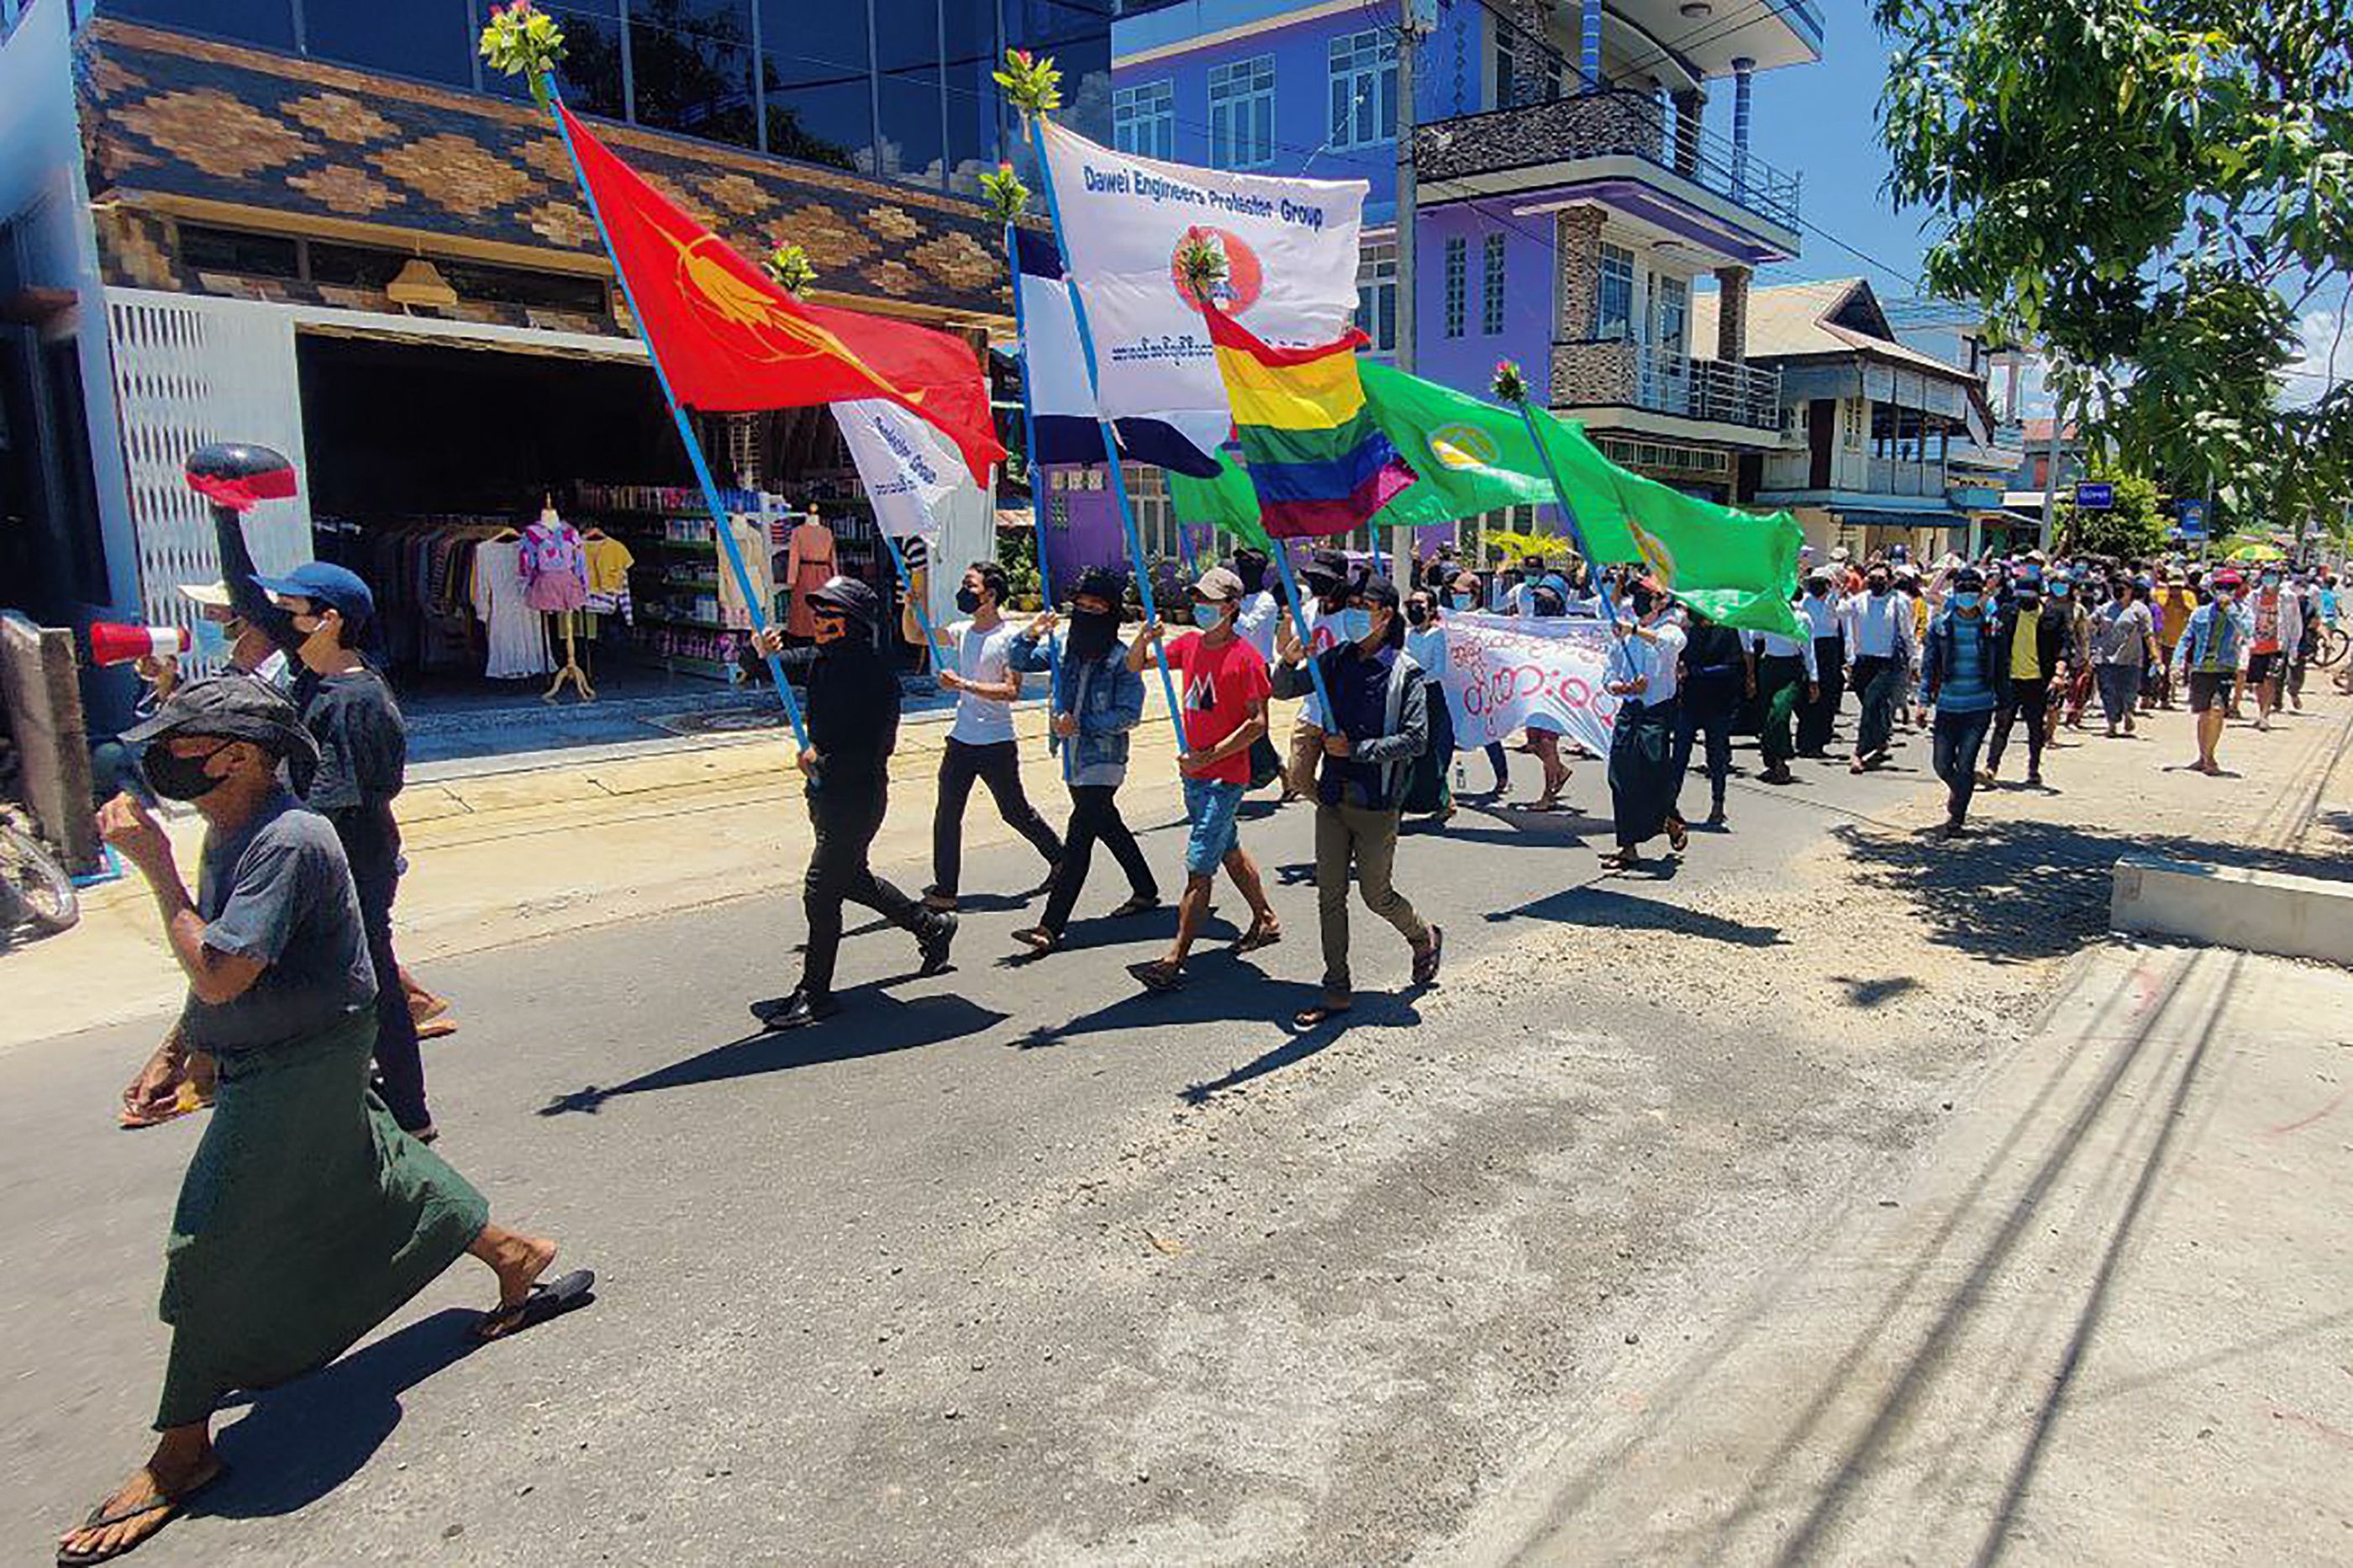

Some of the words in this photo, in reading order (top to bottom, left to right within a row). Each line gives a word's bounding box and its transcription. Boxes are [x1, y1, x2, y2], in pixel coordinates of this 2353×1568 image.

[1083, 165, 1130, 194] Dawei
[1133, 169, 1207, 205] Engineers
[1280, 197, 1324, 233] Group
